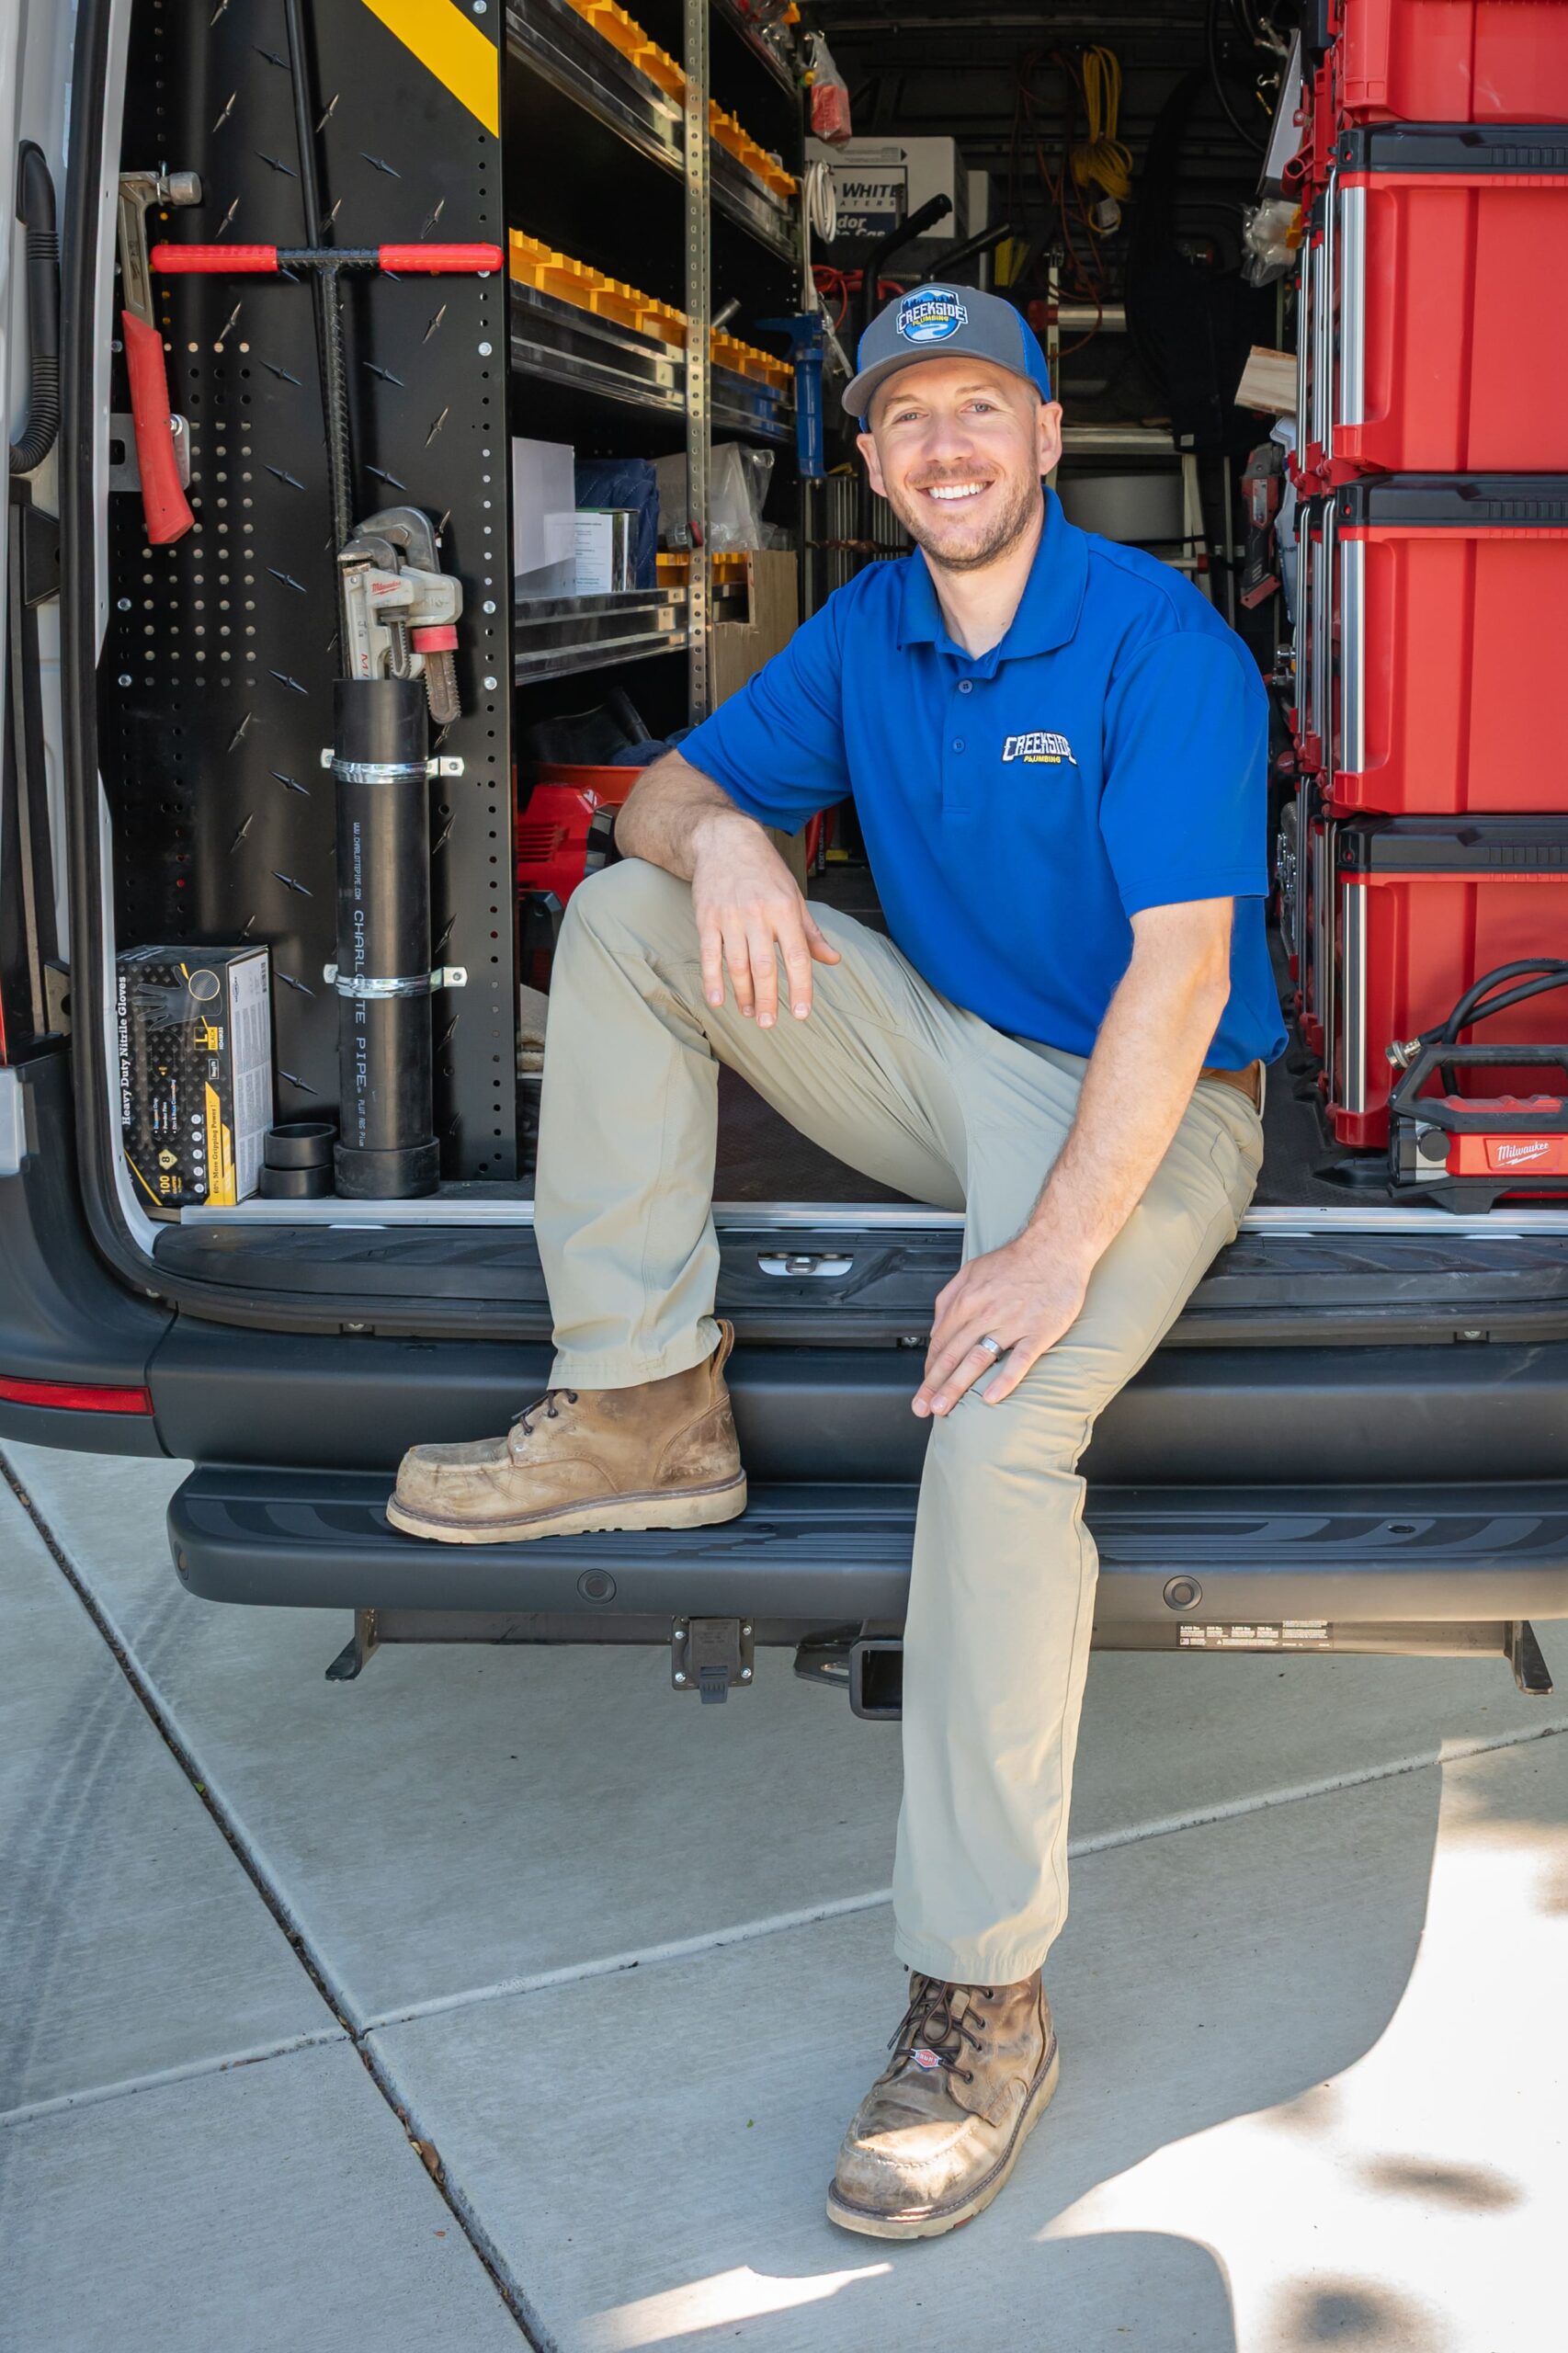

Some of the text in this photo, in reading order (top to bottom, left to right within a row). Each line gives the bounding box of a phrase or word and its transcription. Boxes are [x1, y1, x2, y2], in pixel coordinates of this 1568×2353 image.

[899, 301, 965, 331] CREEKSIDE
[912, 315, 949, 326] PLUMBING
[1023, 755, 1061, 764] PLUMBING
[353, 822, 362, 901] WWW.CHARLOTTEPIPE.COM
[354, 910, 366, 1024] CHARLTE
[118, 976, 131, 1125] Heavy Duty Nitrile Gloves
[194, 1034, 208, 1042] L
[211, 1130, 220, 1160] Gripping
[1497, 1141, 1549, 1161] Milwaukee
[159, 1176, 170, 1194] 100
